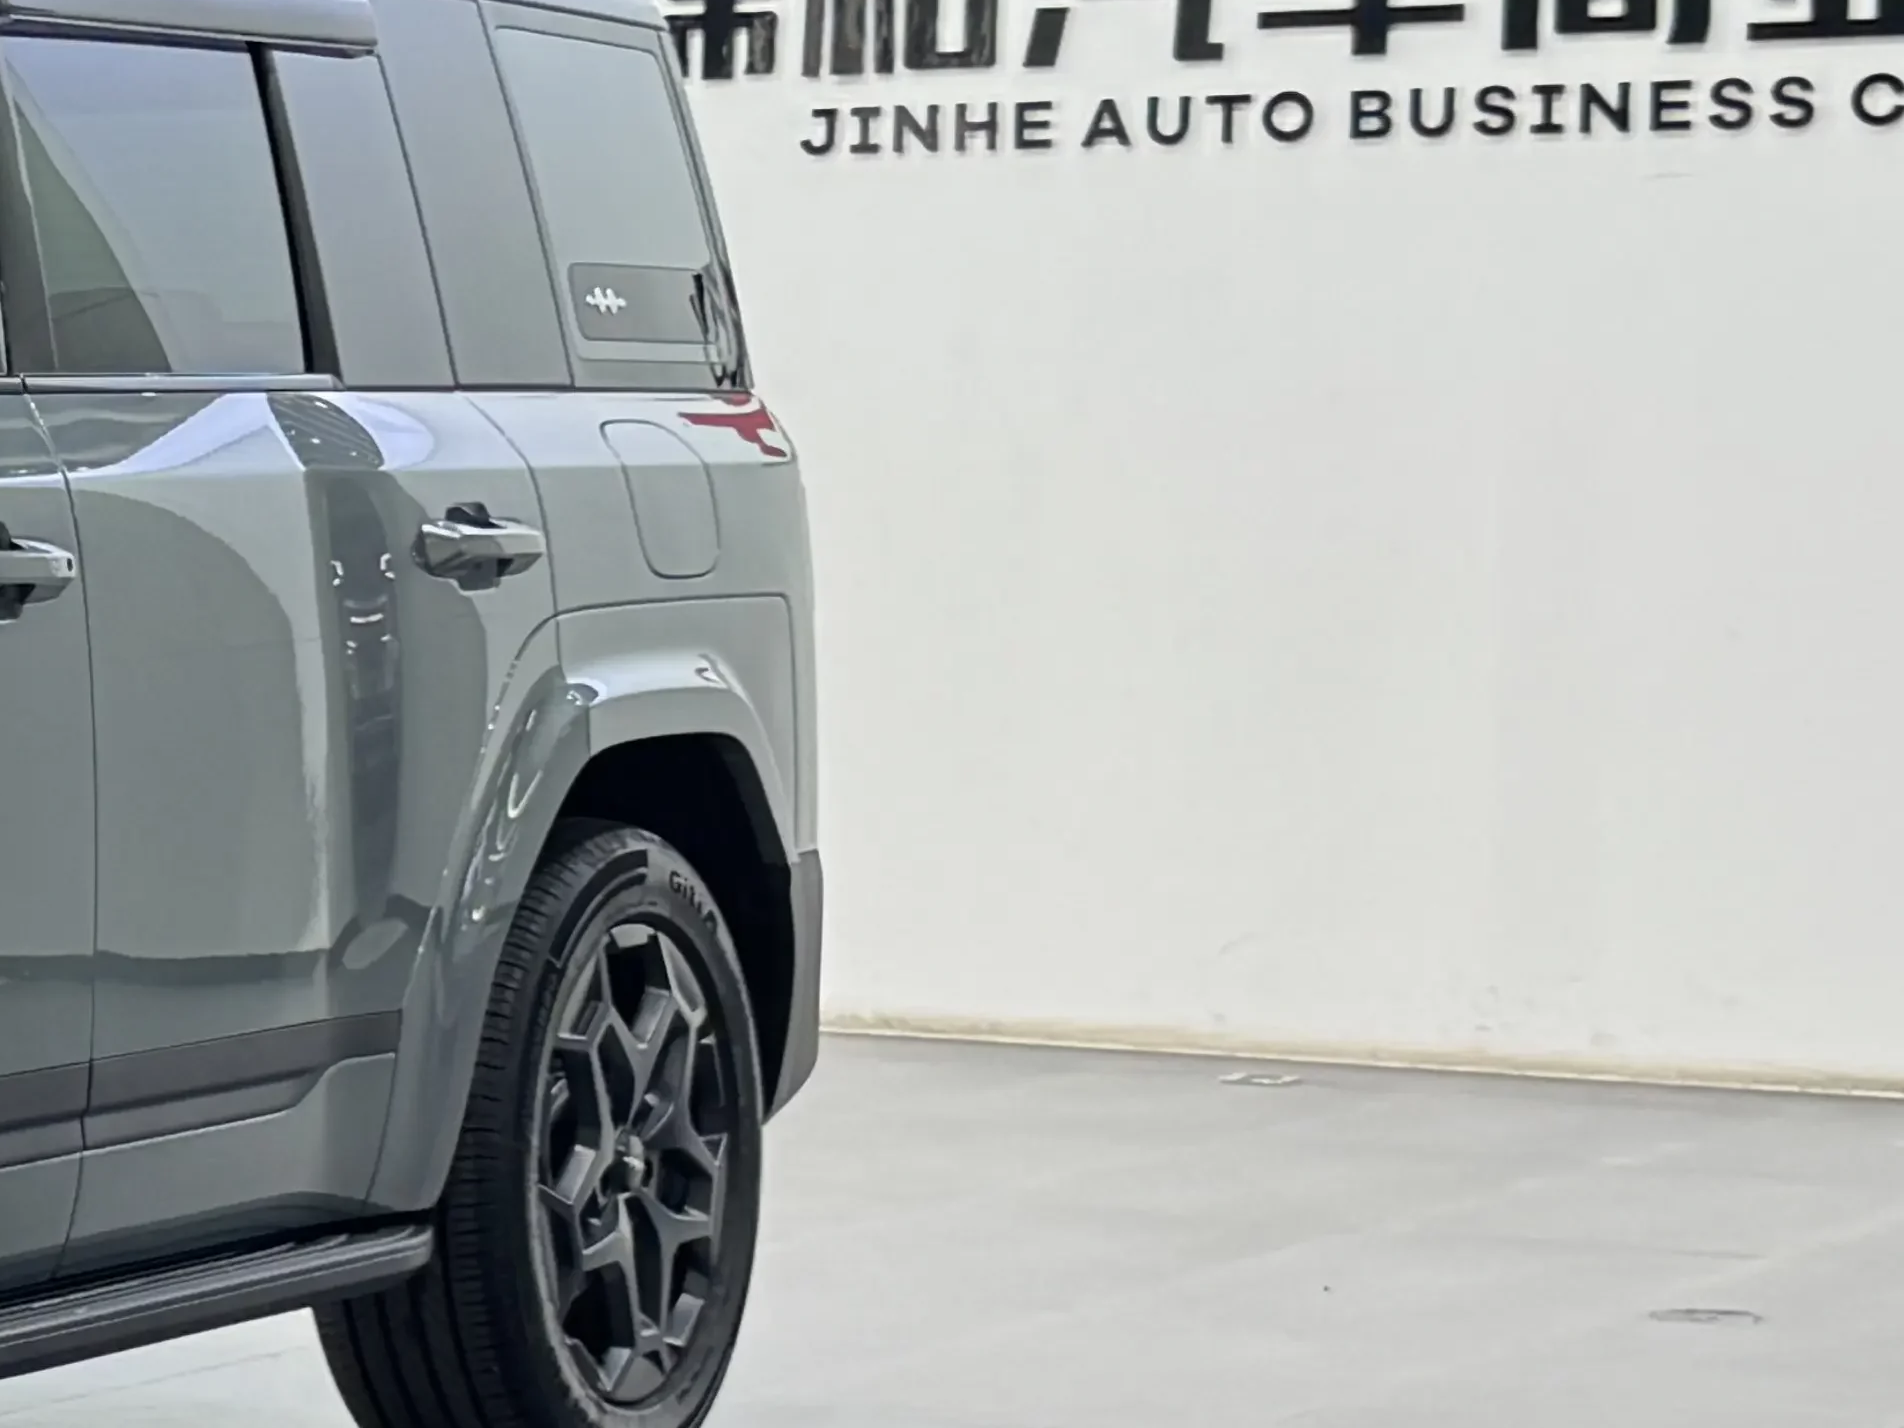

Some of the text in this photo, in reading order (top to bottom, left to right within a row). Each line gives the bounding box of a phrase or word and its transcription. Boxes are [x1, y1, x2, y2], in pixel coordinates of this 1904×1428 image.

[800, 100, 1053, 156] JINHE
[1080, 91, 1314, 147] AUTO
[1349, 75, 1814, 139] BUSINESS
